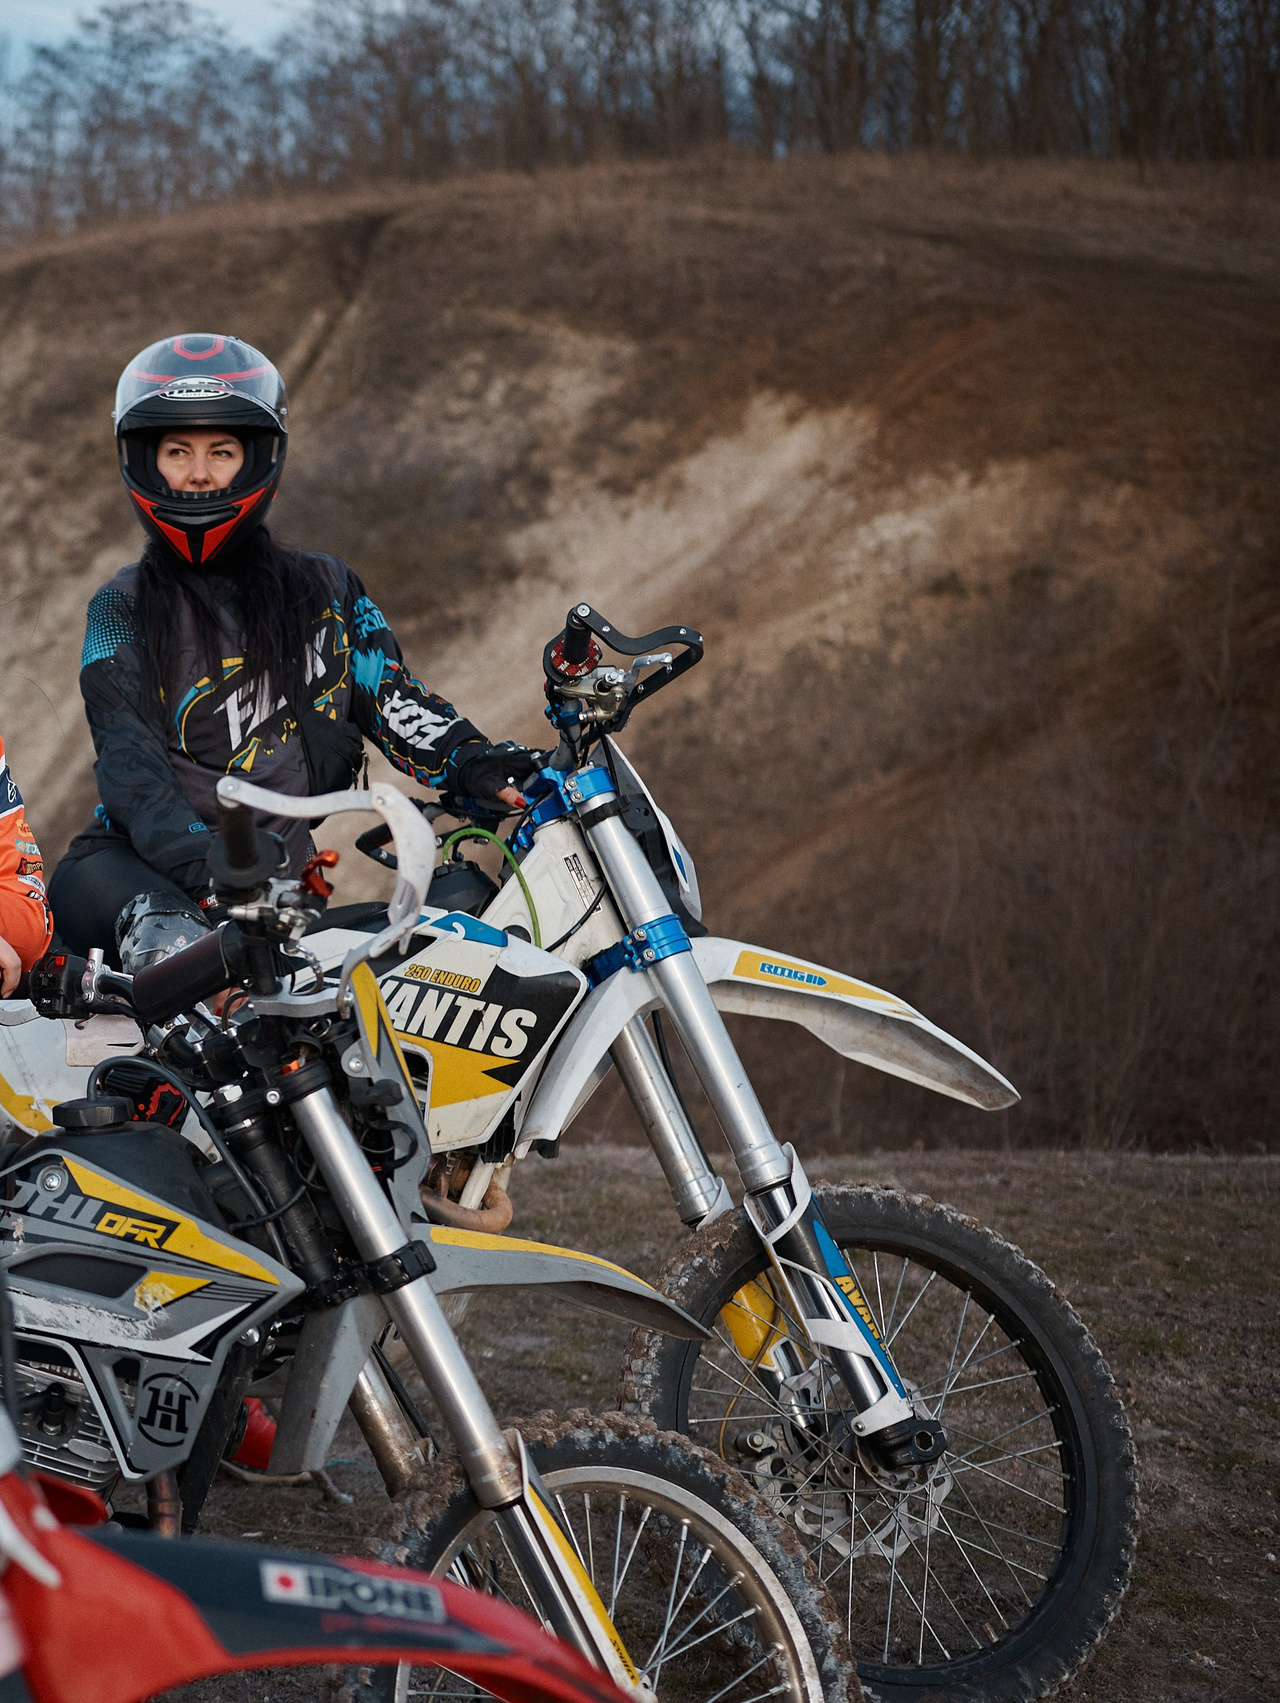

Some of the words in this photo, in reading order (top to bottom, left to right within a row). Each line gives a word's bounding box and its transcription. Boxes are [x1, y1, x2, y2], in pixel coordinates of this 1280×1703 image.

[405, 964, 432, 981] 250
[430, 969, 482, 993] ENDURO
[381, 979, 538, 1058] ANTIS
